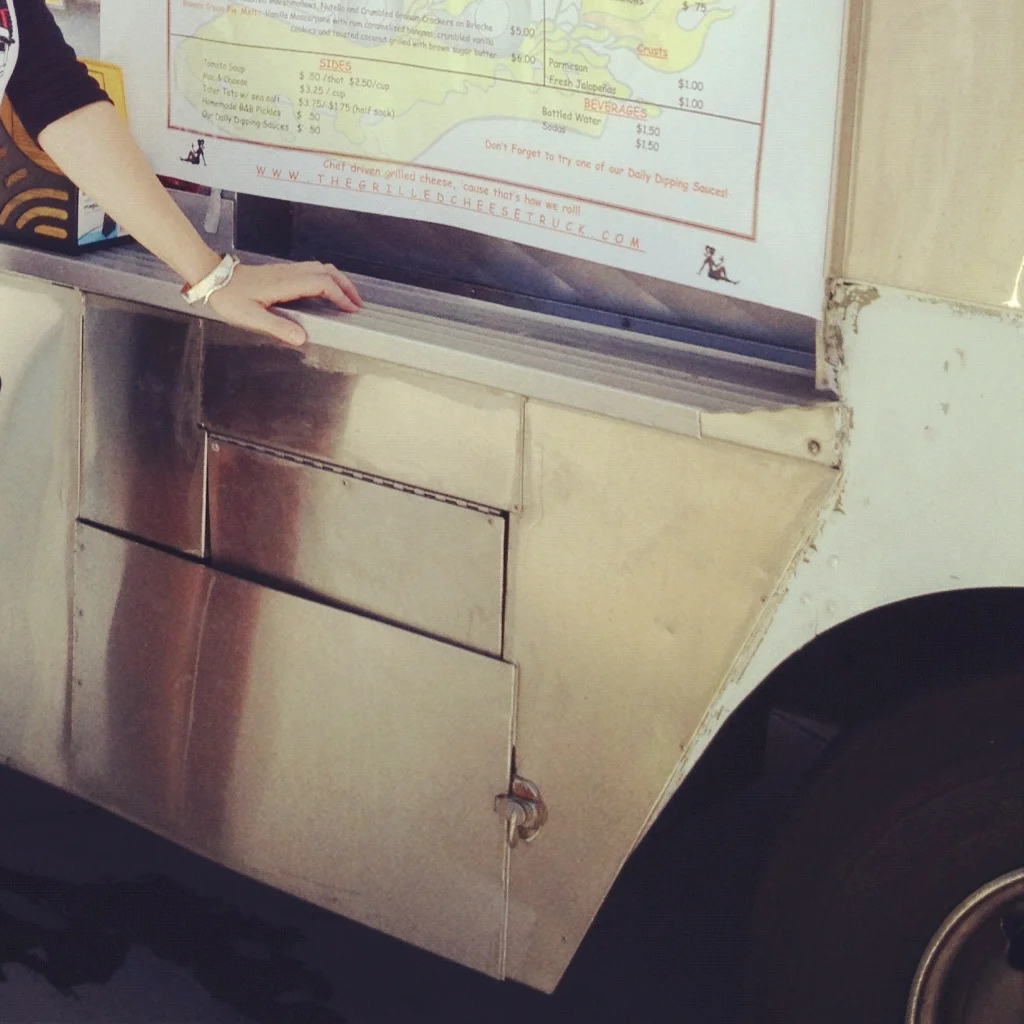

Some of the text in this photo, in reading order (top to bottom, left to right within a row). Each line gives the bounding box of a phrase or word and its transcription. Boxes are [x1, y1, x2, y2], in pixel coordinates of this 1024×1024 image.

[510, 26, 535, 36] $5.00
[637, 44, 668, 58] Crusts
[320, 58, 352, 73] SIDES
[549, 57, 704, 91] Parmesan $1.00
[550, 76, 704, 109] Fresh $1.00
[584, 99, 648, 118] BEVERAGES
[542, 121, 659, 151] Sodas $1.50
[576, 112, 660, 136] Water $1.50
[486, 140, 729, 198] Don't Forget to try one of our Daily Dipping Sauces!
[323, 159, 345, 172] Chef
[350, 163, 381, 176] driven
[385, 168, 415, 183] grilled
[420, 173, 456, 189] cheese,
[525, 194, 541, 206] how
[546, 201, 558, 211] we
